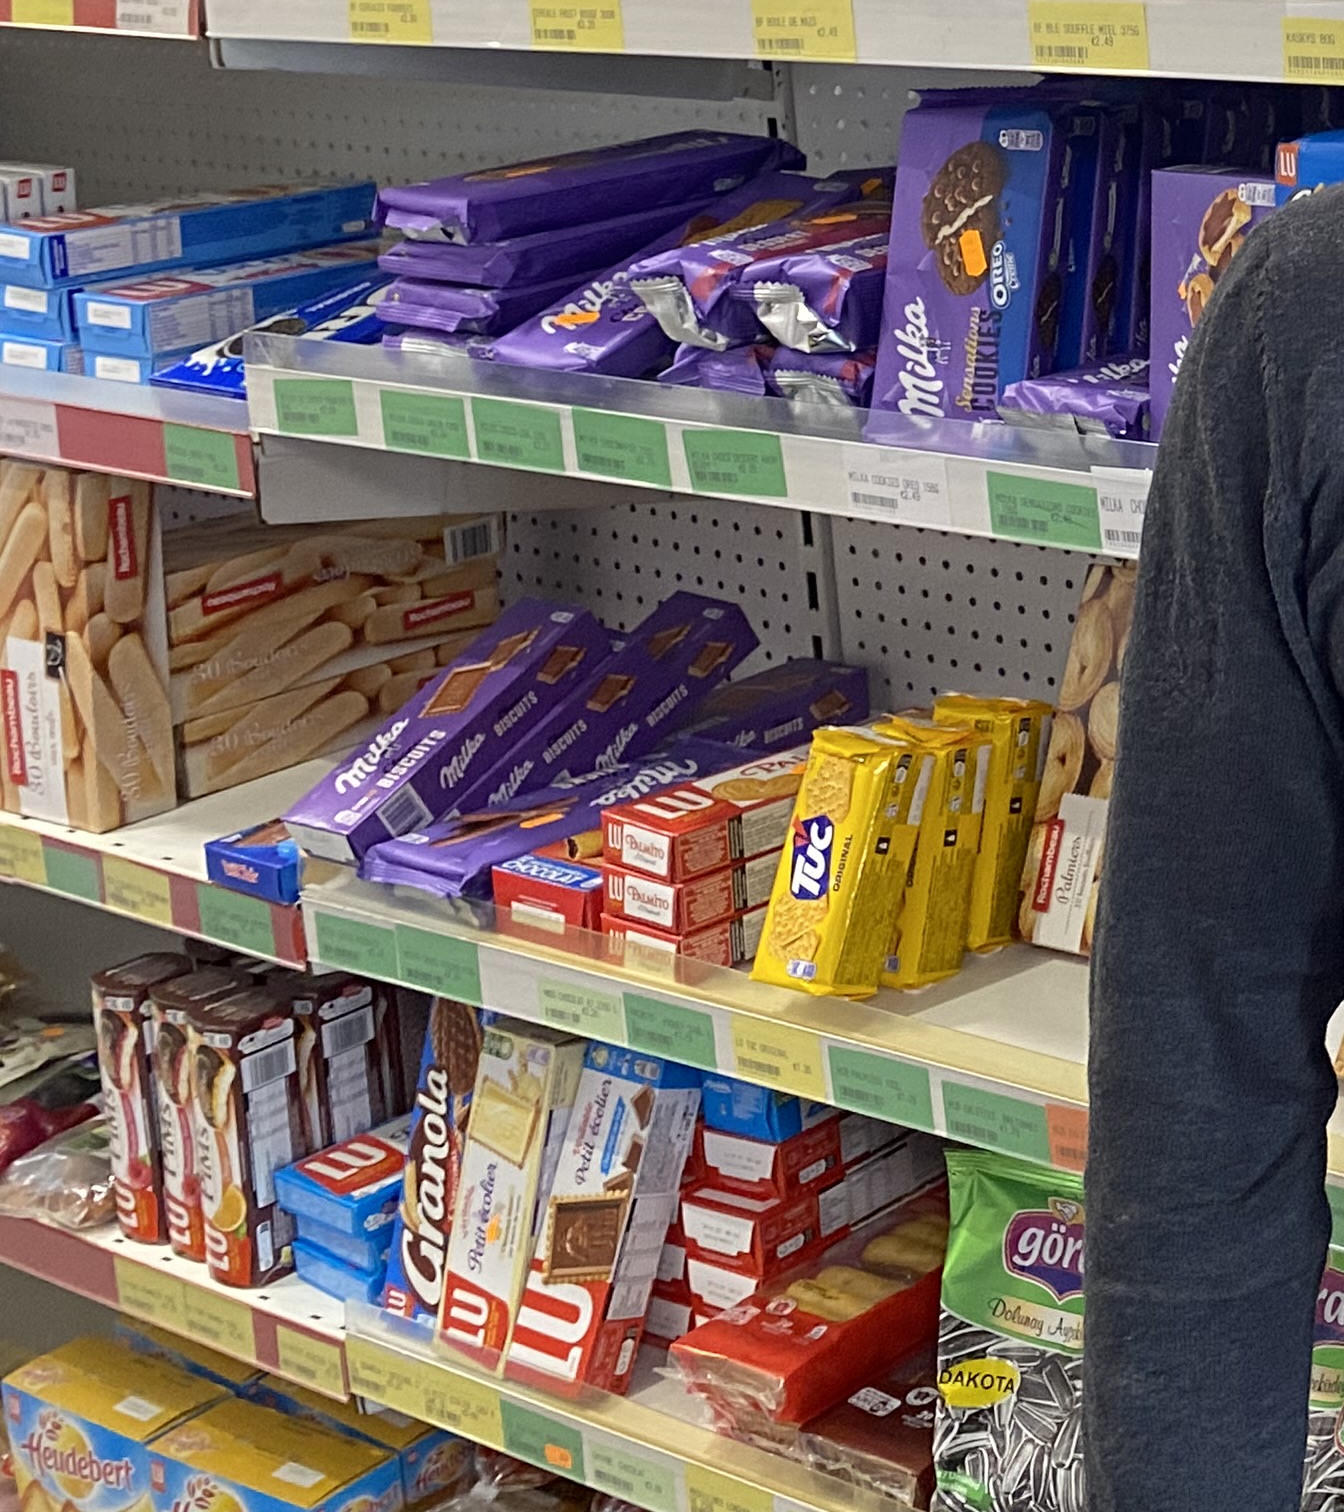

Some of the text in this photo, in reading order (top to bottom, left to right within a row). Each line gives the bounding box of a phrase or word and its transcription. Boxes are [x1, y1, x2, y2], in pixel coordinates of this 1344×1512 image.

[990, 240, 1010, 308] OREO
[897, 295, 946, 418] Milka
[955, 306, 982, 413] Sensations
[493, 691, 539, 738] BISCUITS
[542, 719, 588, 765] BISCUITS
[334, 718, 411, 795] Milka
[376, 729, 447, 789] BISCUITS
[439, 733, 487, 789] Milka
[632, 790, 716, 821] LU
[607, 823, 623, 851] LU
[792, 819, 834, 898] TUC
[832, 833, 855, 893] ORIGINAL
[1036, 822, 1060, 905] Rochambeau
[304, 1145, 389, 1180] LU
[400, 1066, 451, 1309] Granola
[446, 1287, 491, 1350] LU
[937, 1367, 1016, 1397] DAKOTA
[22, 1430, 136, 1489] Heudebert
